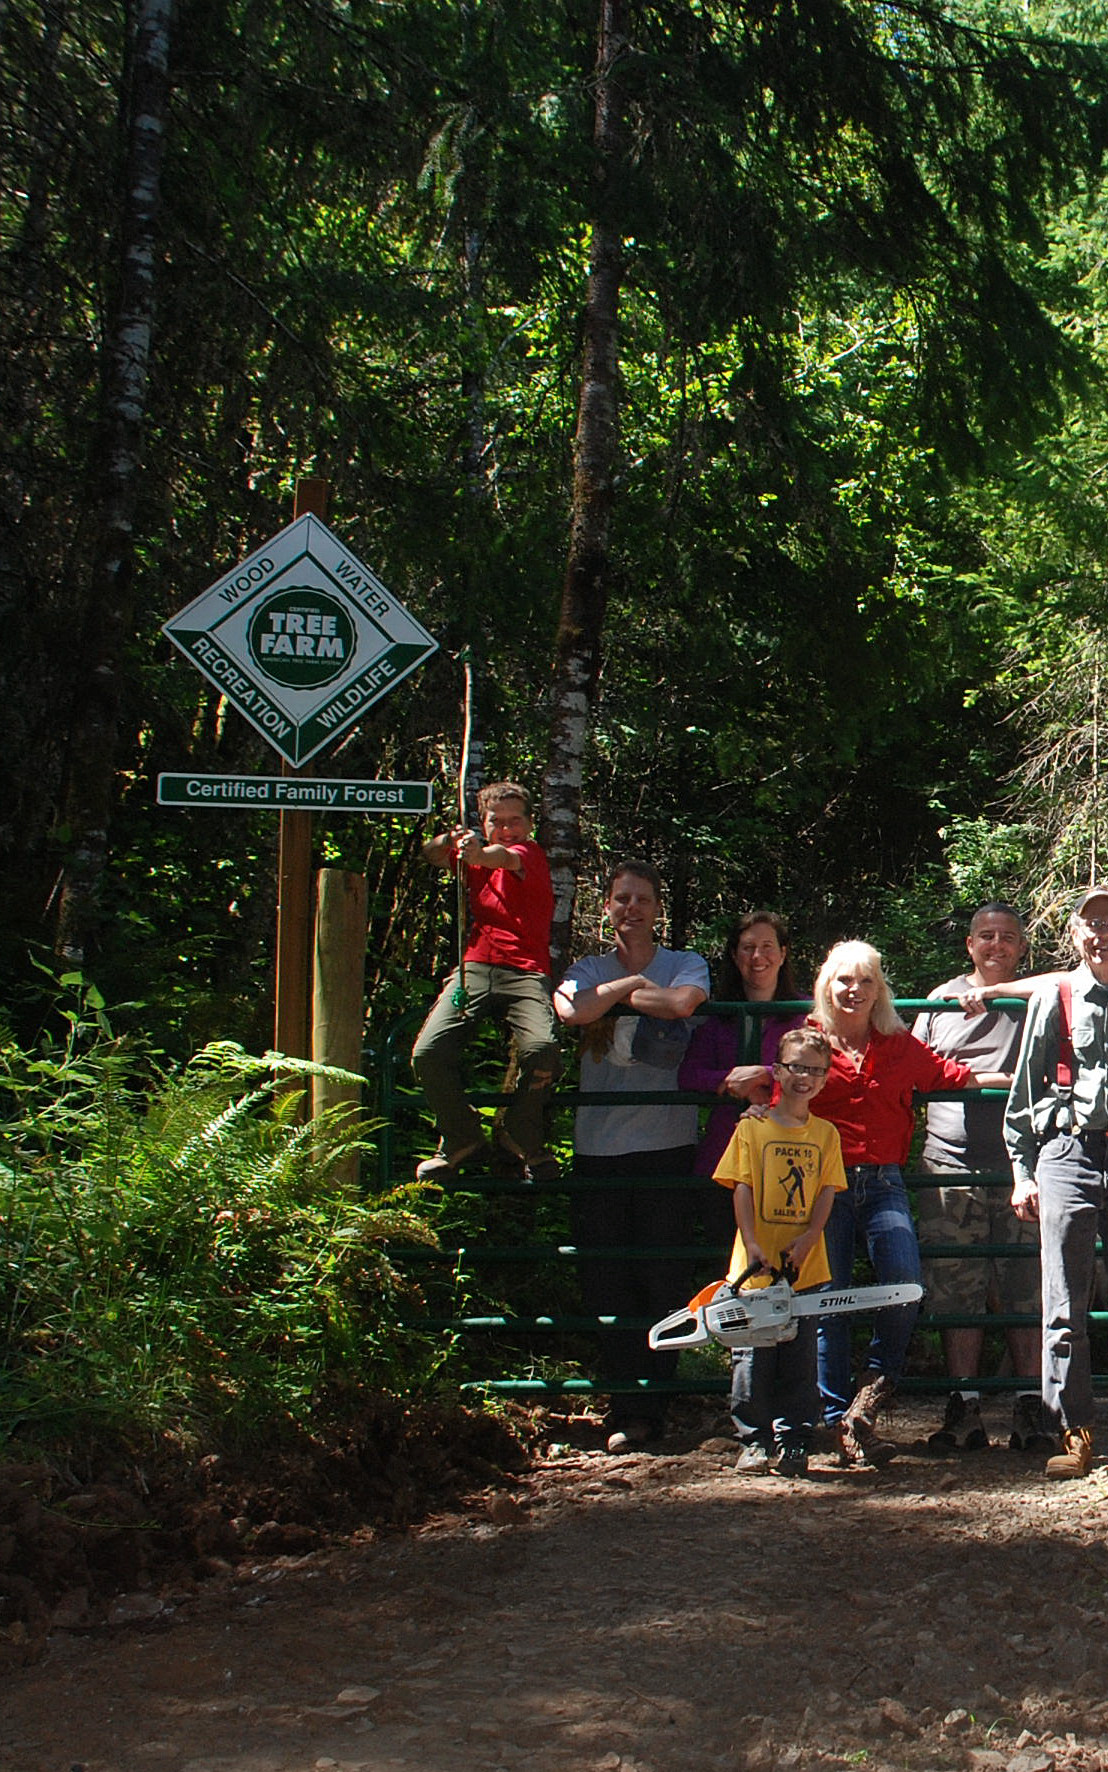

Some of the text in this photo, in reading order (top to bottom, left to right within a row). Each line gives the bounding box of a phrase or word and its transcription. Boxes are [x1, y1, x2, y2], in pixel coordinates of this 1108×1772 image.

[218, 557, 275, 604] WOOD
[334, 559, 391, 618] WATER
[269, 612, 337, 636] TREE
[260, 633, 345, 658] FARM
[191, 637, 292, 739] RECREATION
[316, 659, 398, 729] WILDLIFE
[186, 780, 405, 804] Certified Family Forest
[775, 1147, 801, 1157] PACK
[819, 1295, 855, 1308] STIHL
